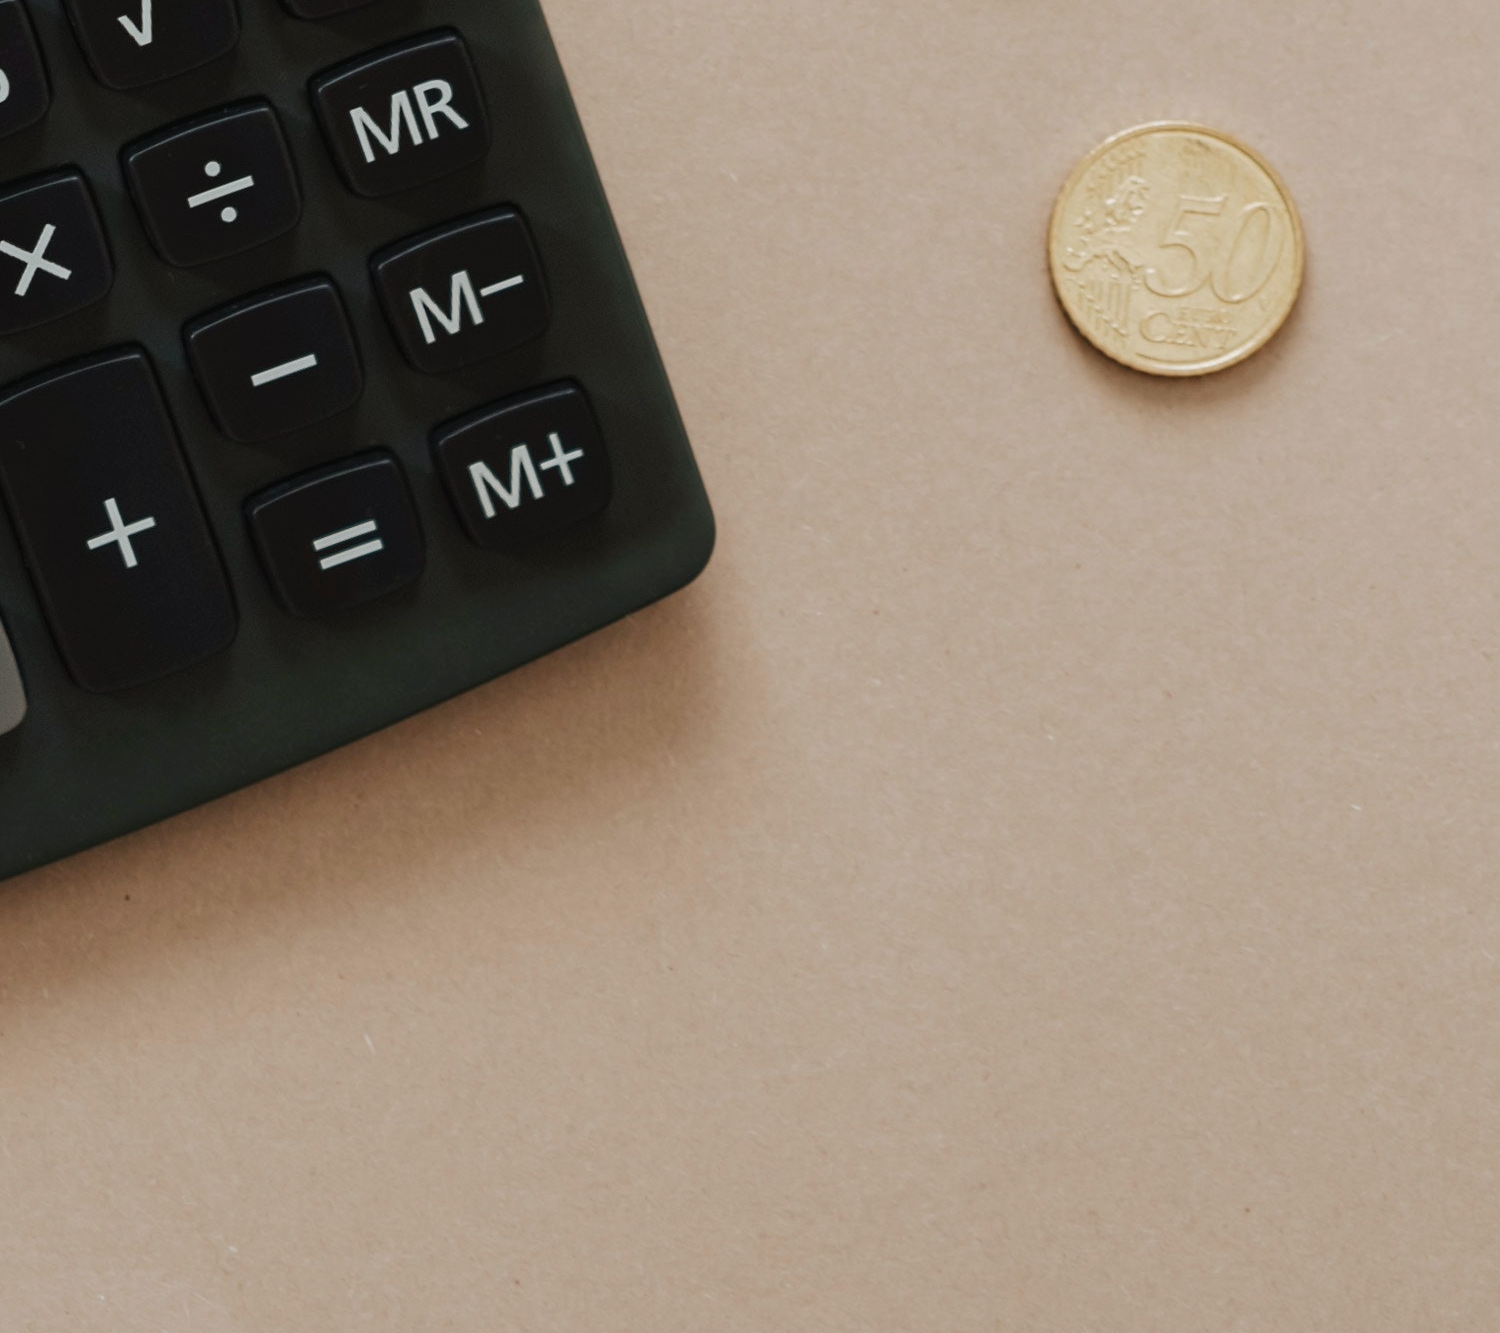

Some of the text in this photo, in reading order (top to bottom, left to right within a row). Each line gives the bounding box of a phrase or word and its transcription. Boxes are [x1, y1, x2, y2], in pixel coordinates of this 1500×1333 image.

[349, 79, 469, 163] MR
[1142, 193, 1283, 304] 50
[1139, 313, 1237, 349] CENT
[468, 432, 584, 518] M+
